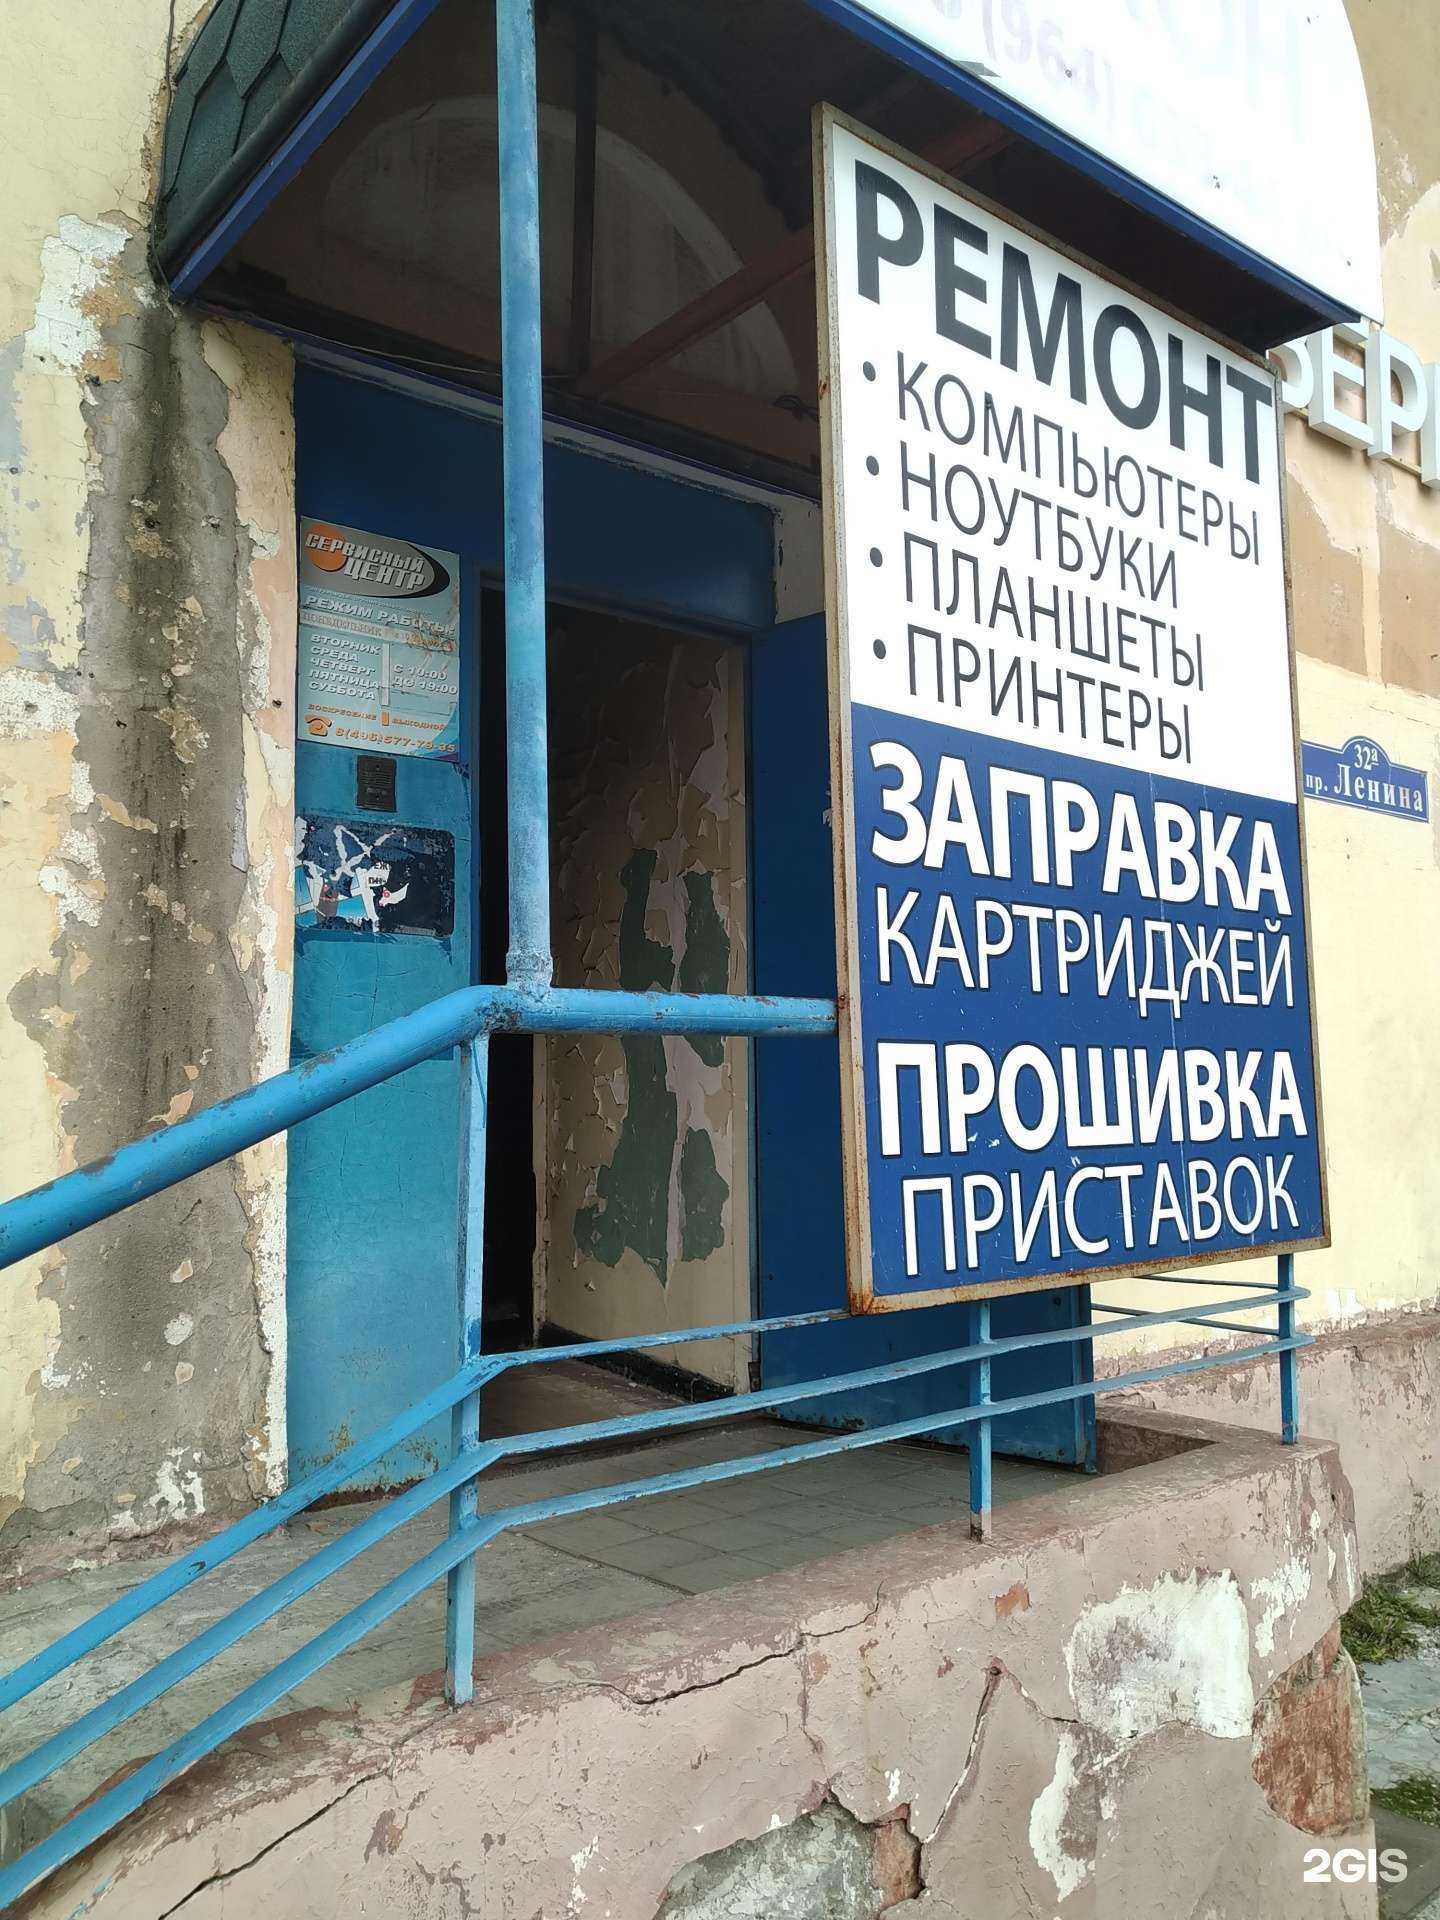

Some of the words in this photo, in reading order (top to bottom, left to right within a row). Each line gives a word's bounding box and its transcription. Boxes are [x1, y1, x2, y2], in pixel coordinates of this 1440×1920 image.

[855, 160, 1272, 485] РЕМОНТ
[897, 351, 1260, 566] КОМПЬЮТЕРЫ
[900, 440, 1178, 609] НОУТБУКИ
[304, 533, 425, 574] СЕРВИСНЫЙ
[344, 558, 425, 590] ЦЕНТР
[304, 595, 373, 619] РЕЖИМ
[904, 531, 1204, 692] ПЛАНШЕТЫ
[310, 634, 382, 656] ВТОРНИК
[310, 657, 376, 677] ЧЕТВЕРГ
[311, 645, 359, 663] СРЕДА
[308, 681, 376, 701] СУББОТА
[309, 669, 381, 690] ПЯТНИЦА
[908, 624, 1192, 764] ПРИНТЕРЫ
[1354, 744, 1379, 770] 32а
[1305, 774, 1328, 794] пр.
[1334, 763, 1423, 812] Ленина
[870, 741, 1293, 916] ЗАПРАВКА
[876, 887, 1294, 1018] КАРТРИДЖЕЙ
[877, 1042, 1307, 1156] ПРОШИВКА
[902, 1155, 1299, 1277] ПРИСТАВОК
